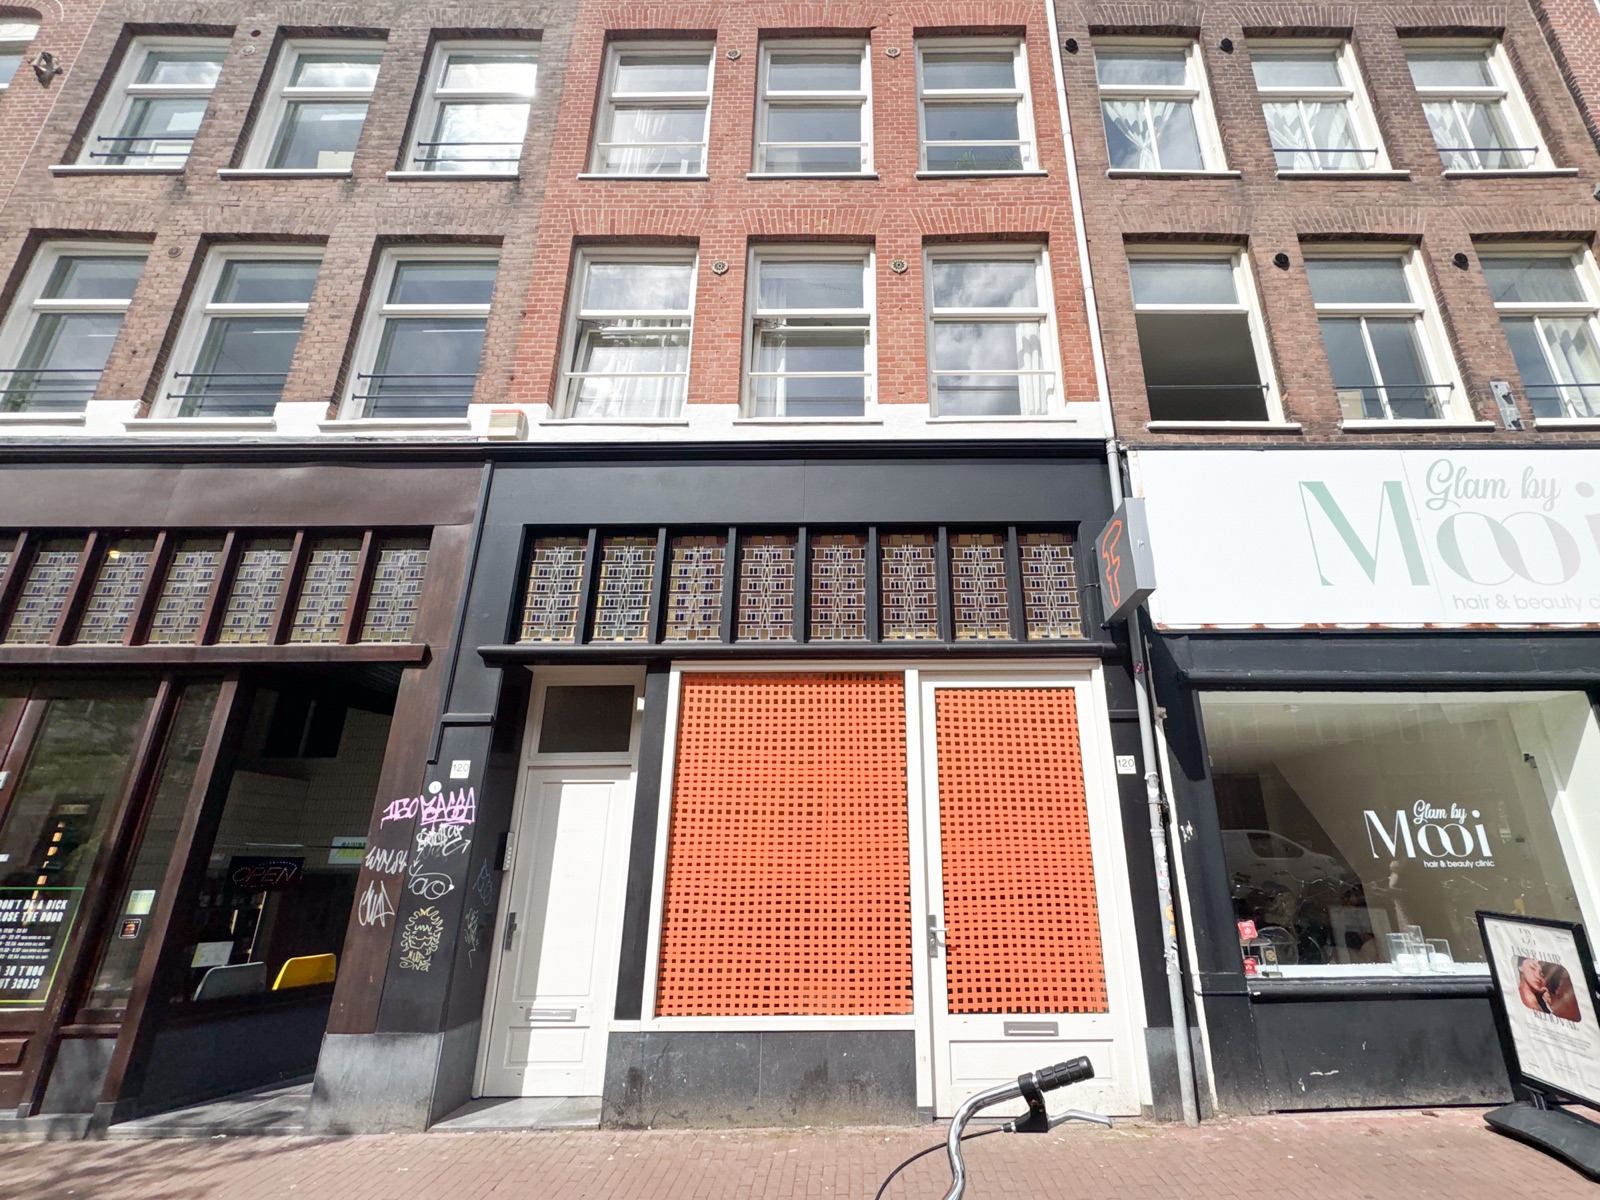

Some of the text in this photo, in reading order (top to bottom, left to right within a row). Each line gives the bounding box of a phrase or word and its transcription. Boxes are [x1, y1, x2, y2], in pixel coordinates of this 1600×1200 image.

[1426, 458, 1561, 512] Glam by
[1453, 594, 1490, 610] hair
[1495, 594, 1511, 610] &
[1513, 594, 1583, 614] beauty
[453, 763, 469, 773] 120
[1117, 758, 1134, 768] 120
[1413, 799, 1468, 825] Glam by
[1363, 809, 1493, 858] Mooi
[1423, 860, 1495, 869] hair & beauty clinic
[231, 866, 298, 883] OPEN
[23, 899, 38, 910] BE
[36, 899, 44, 910] A
[45, 899, 69, 910] DICK
[21, 911, 39, 923] THE
[39, 911, 64, 923] DOOR
